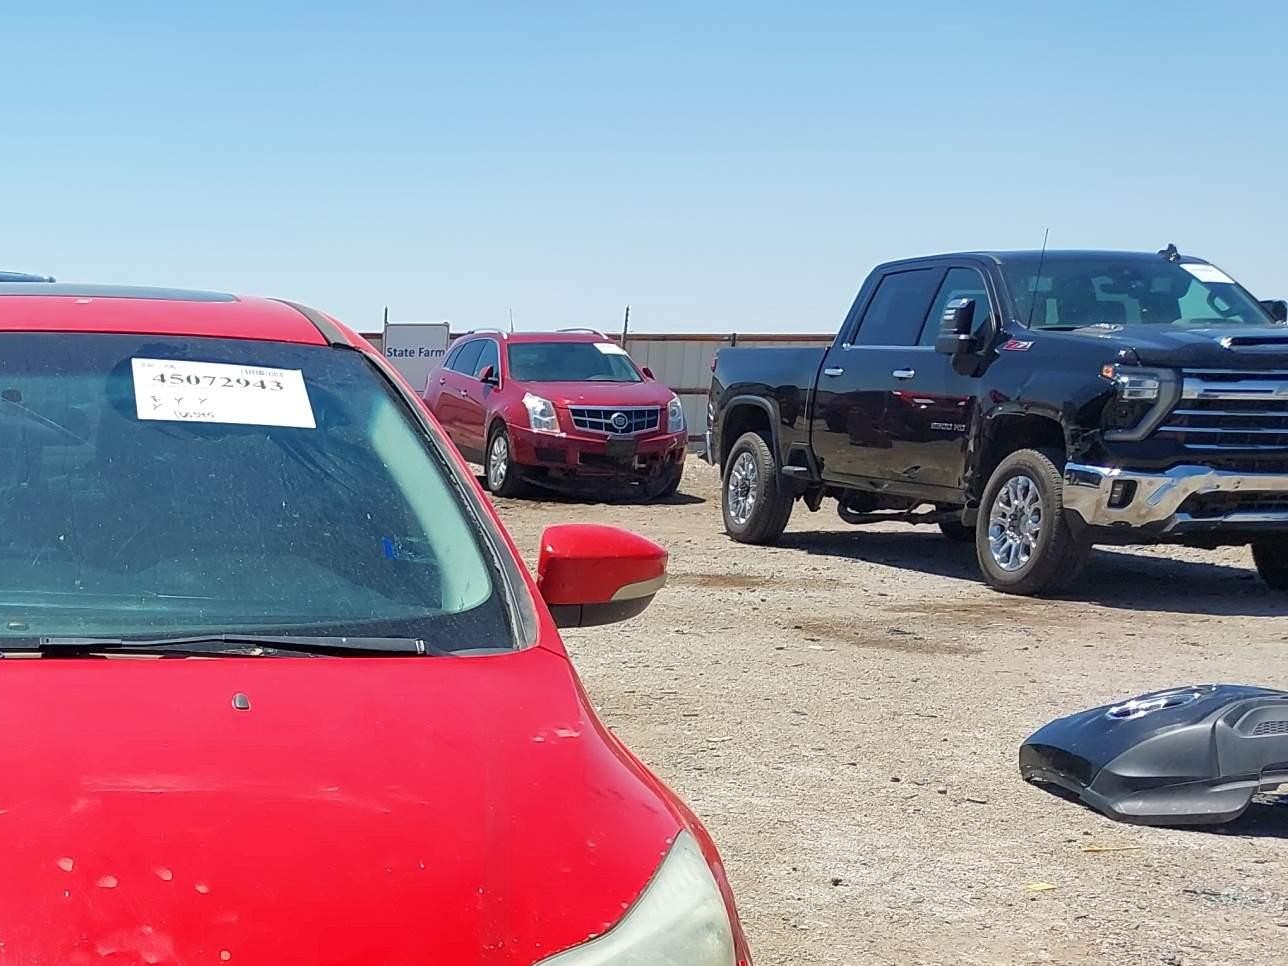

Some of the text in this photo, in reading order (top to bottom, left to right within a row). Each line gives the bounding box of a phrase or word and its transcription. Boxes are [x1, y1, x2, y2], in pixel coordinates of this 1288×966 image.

[386, 347, 445, 357] State Farm
[152, 372, 284, 391] 45072943
